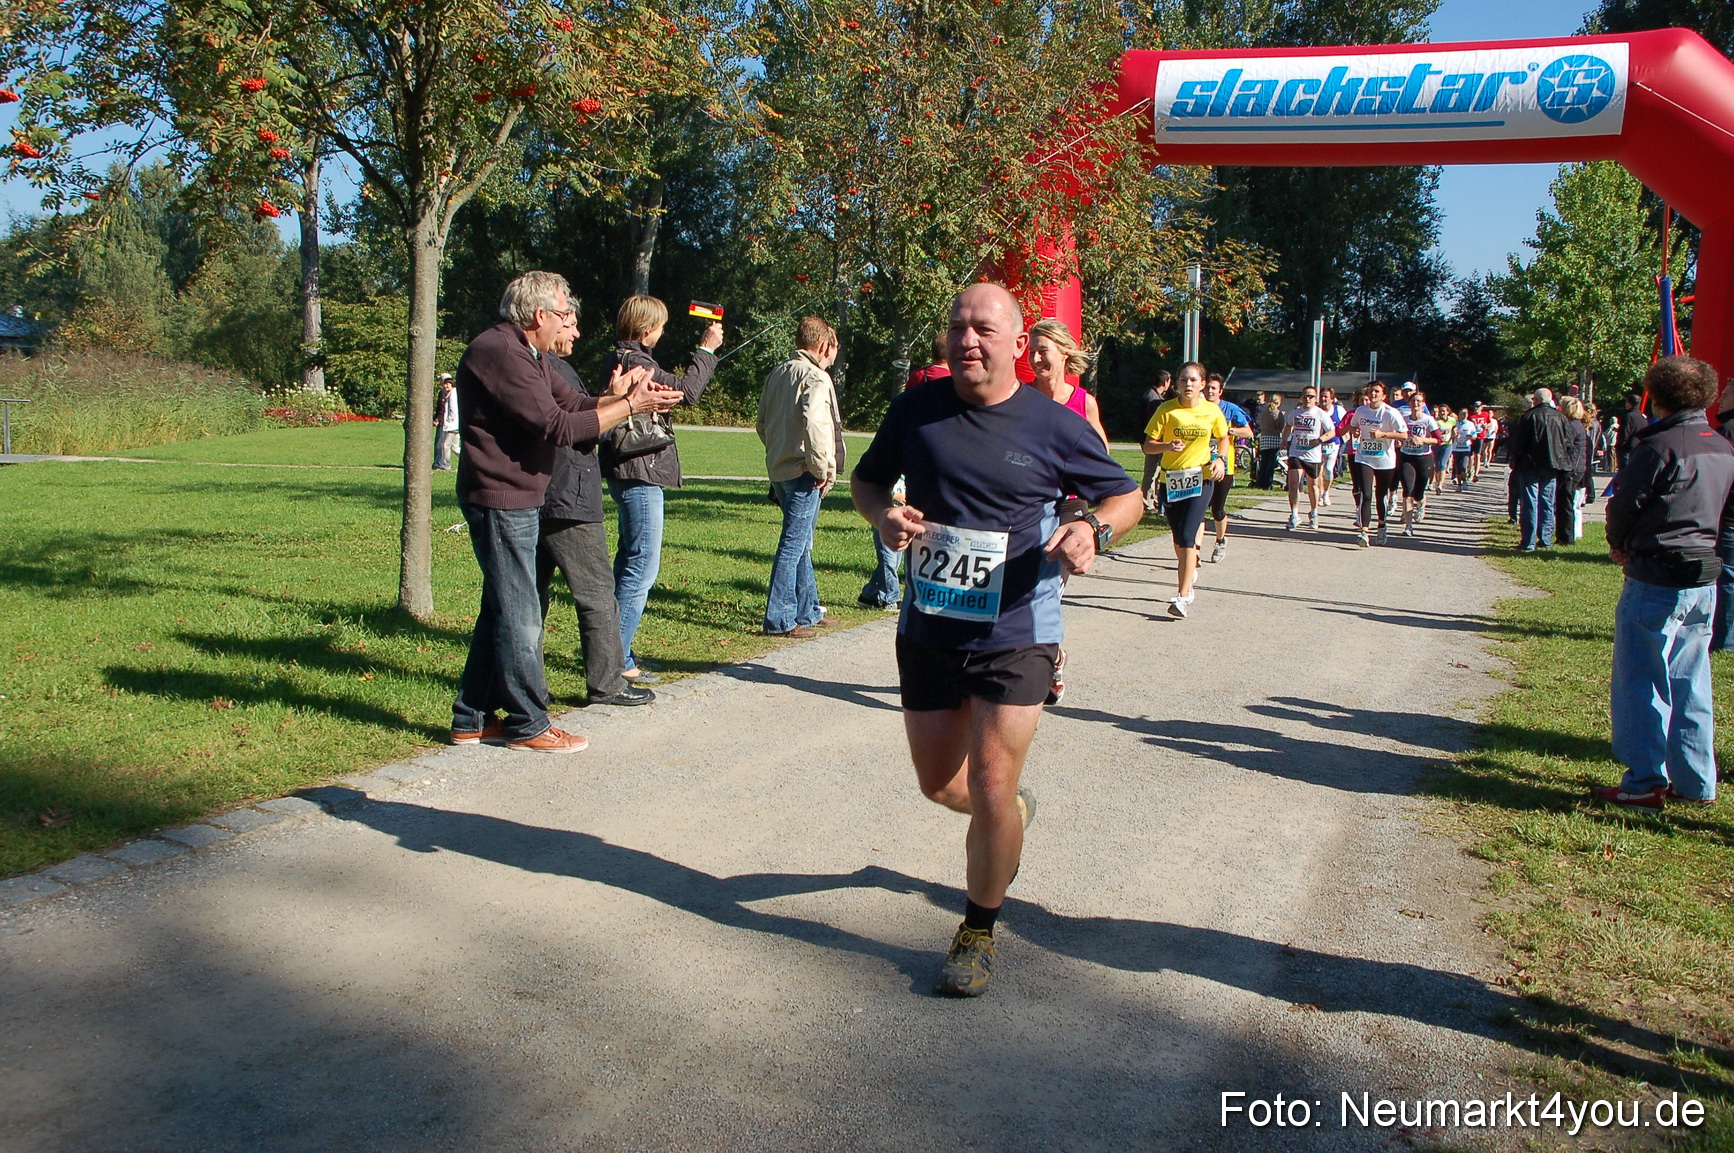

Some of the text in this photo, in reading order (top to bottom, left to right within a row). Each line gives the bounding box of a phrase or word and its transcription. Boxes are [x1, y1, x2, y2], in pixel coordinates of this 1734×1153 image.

[1362, 441, 1383, 451] 3238
[1170, 475, 1199, 490] 3125
[918, 545, 992, 589] 2245
[916, 580, 988, 609] Siegfried
